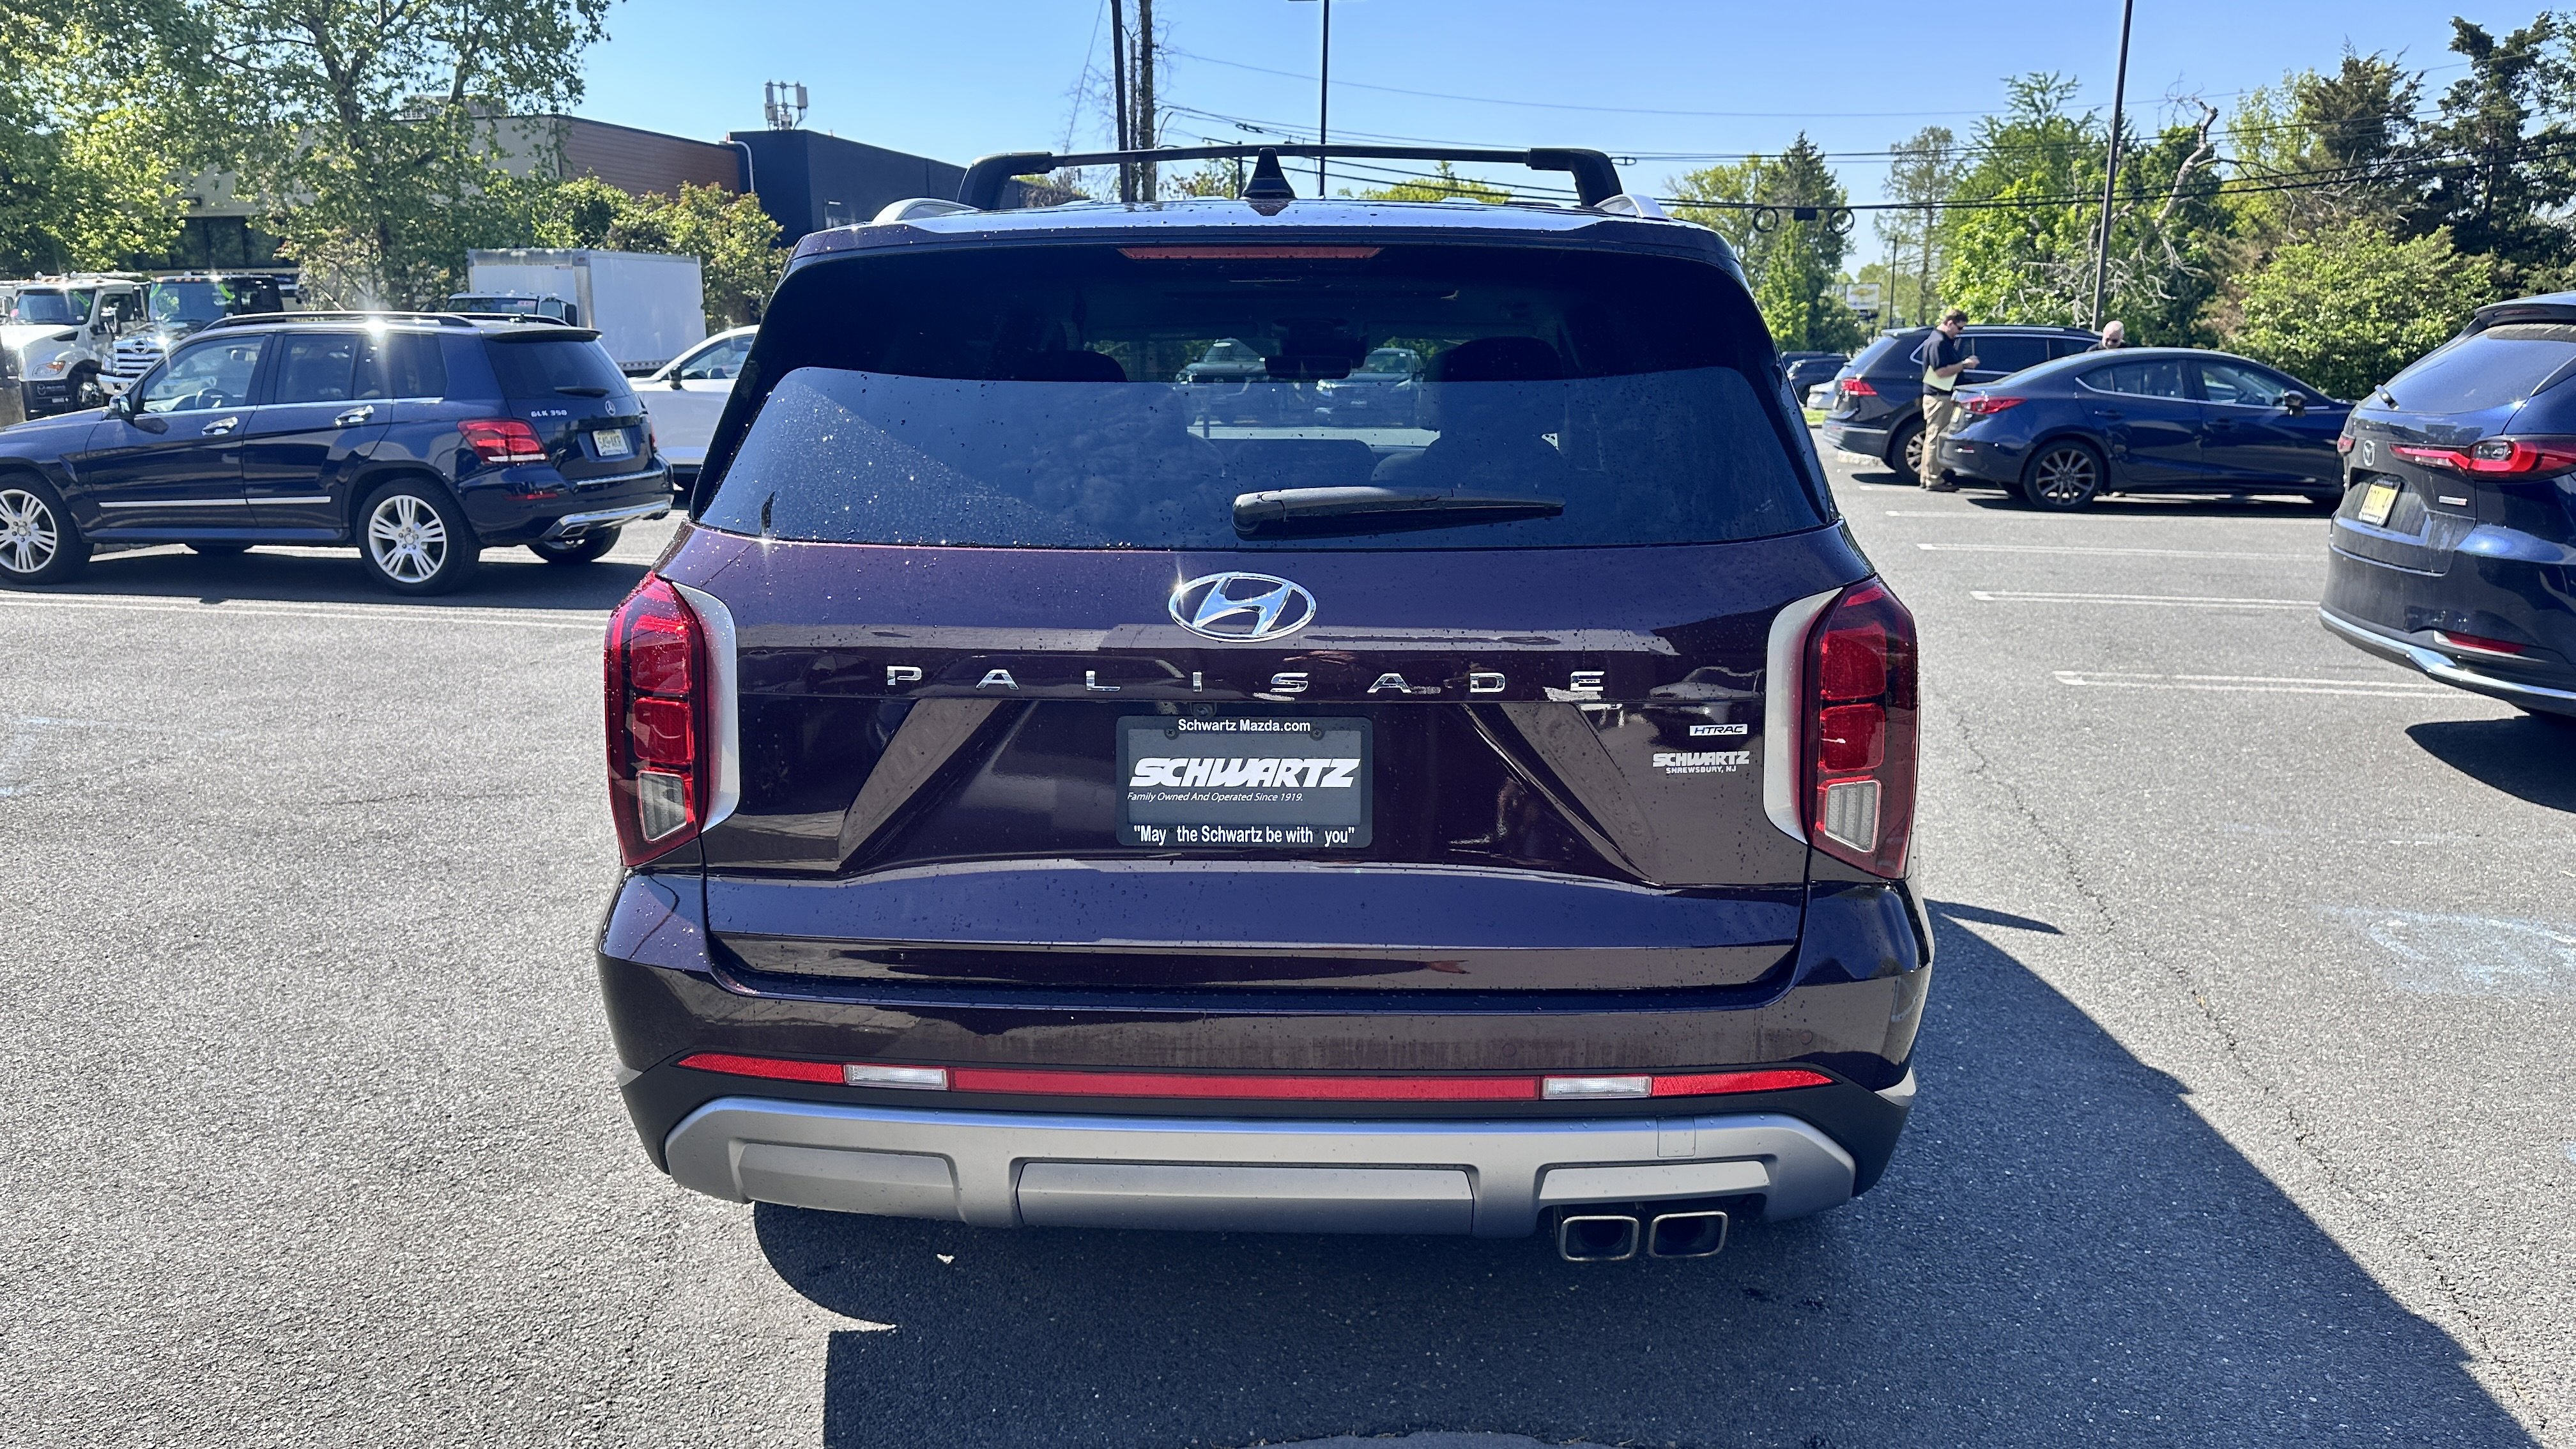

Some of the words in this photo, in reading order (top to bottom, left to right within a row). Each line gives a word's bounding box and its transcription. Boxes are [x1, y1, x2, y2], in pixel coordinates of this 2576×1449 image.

[887, 665, 1605, 694] PALISADE
[1178, 719, 1237, 732] Schwartz
[1239, 719, 1310, 732] Mazda.com
[1694, 725, 1743, 734] HTRAC
[1652, 751, 1750, 767] SCHWARTZ
[1129, 758, 1361, 788] SCHWARTZ
[1127, 792, 1156, 801] Family
[1158, 792, 1189, 801] Owned
[1190, 792, 1209, 801] And
[1211, 792, 1253, 802] Operated
[1255, 792, 1278, 801] Since
[1280, 793, 1303, 802] 1919.
[1134, 825, 1167, 845] "May
[1177, 825, 1199, 842] the
[1201, 825, 1262, 843] Schwartz
[1266, 827, 1282, 843] be
[1285, 827, 1314, 843] with
[1324, 827, 1355, 847] you"
